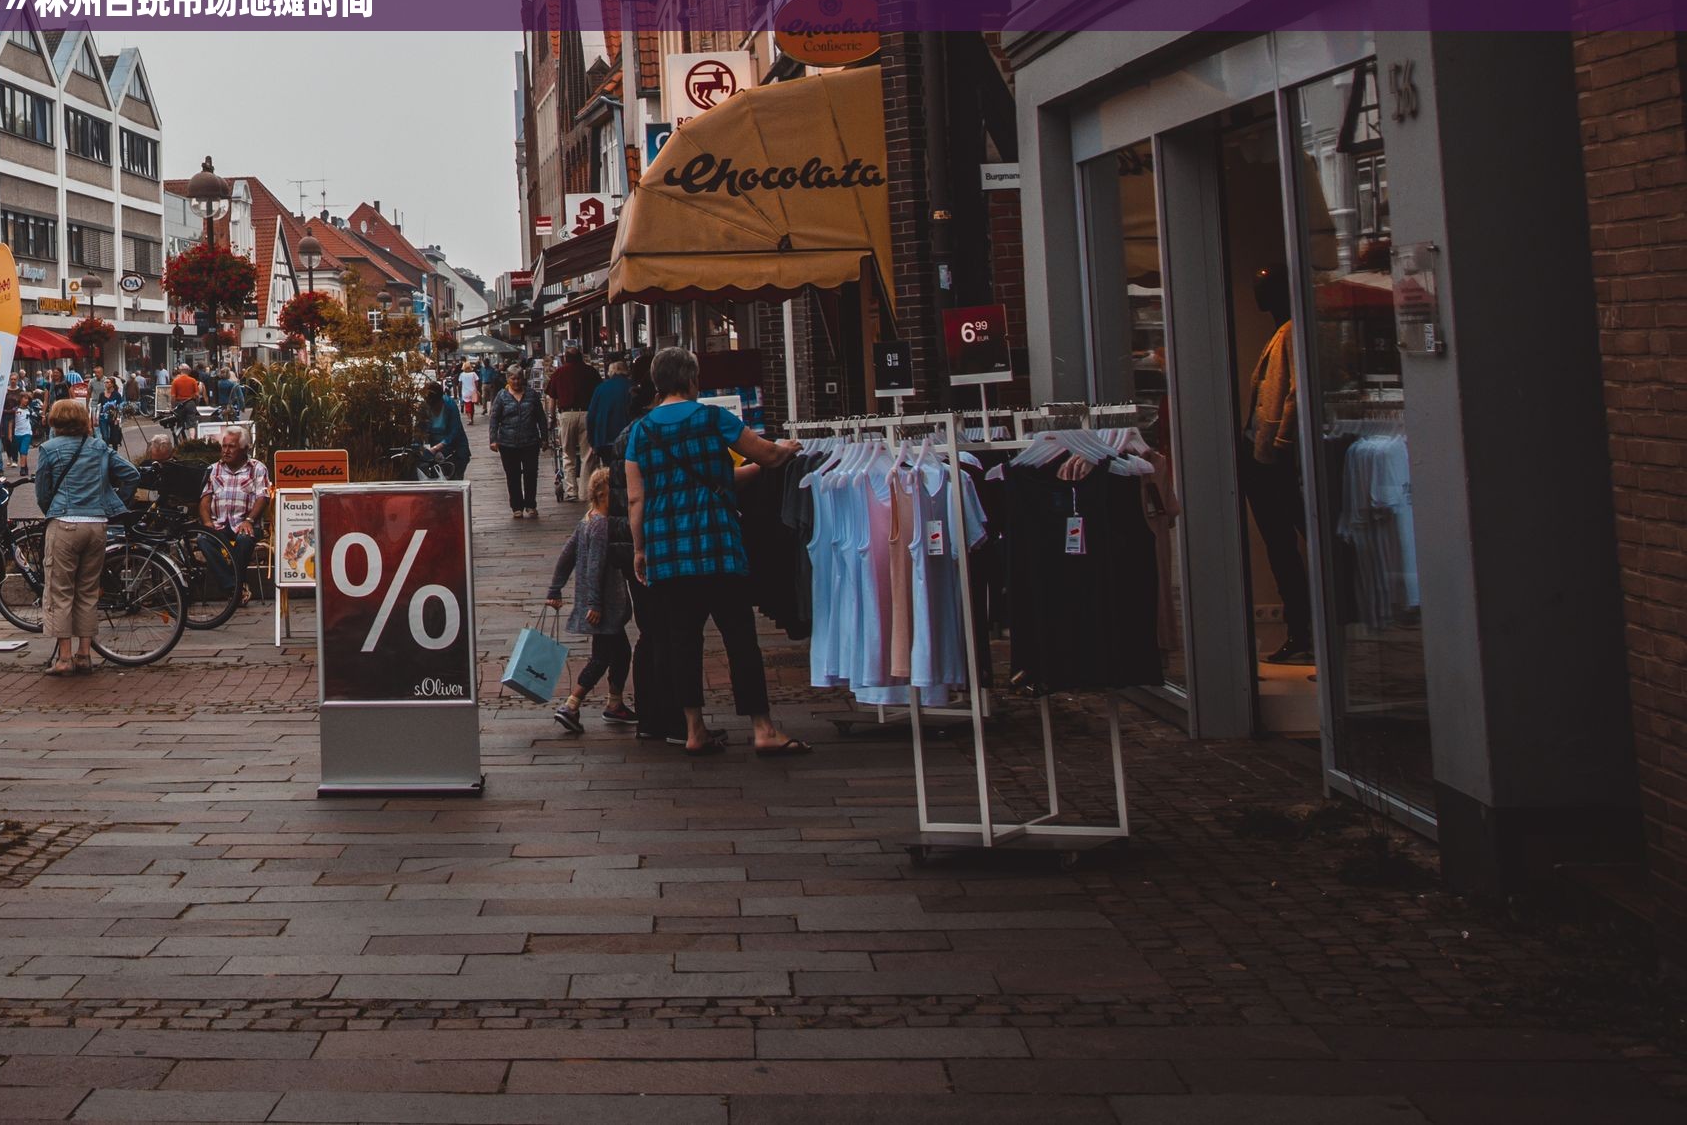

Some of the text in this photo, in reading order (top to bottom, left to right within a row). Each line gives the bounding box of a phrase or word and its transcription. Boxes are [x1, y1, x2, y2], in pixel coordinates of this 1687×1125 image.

[664, 153, 885, 195] Chocolata
[960, 322, 976, 343] 6
[279, 464, 344, 478] Chocolata
[283, 571, 298, 579] 150
[414, 677, 464, 696] s.Oliver
